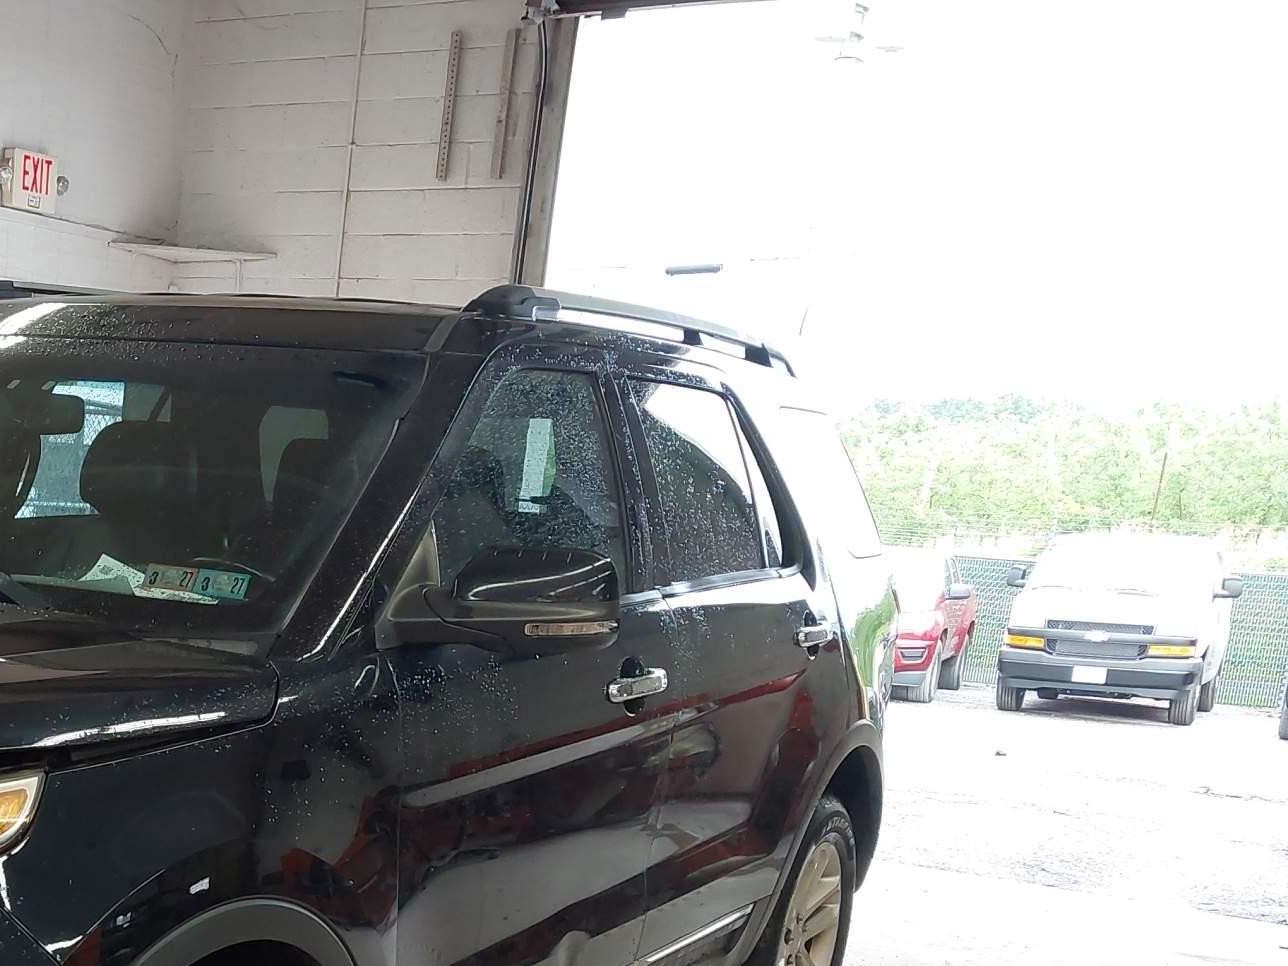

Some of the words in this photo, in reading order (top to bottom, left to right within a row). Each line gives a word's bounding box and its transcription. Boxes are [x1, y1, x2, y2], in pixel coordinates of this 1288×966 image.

[22, 154, 52, 195] EXIT
[148, 571, 159, 585] 3
[178, 571, 194, 588] 27
[200, 576, 211, 592] 3
[229, 577, 246, 595] 27
